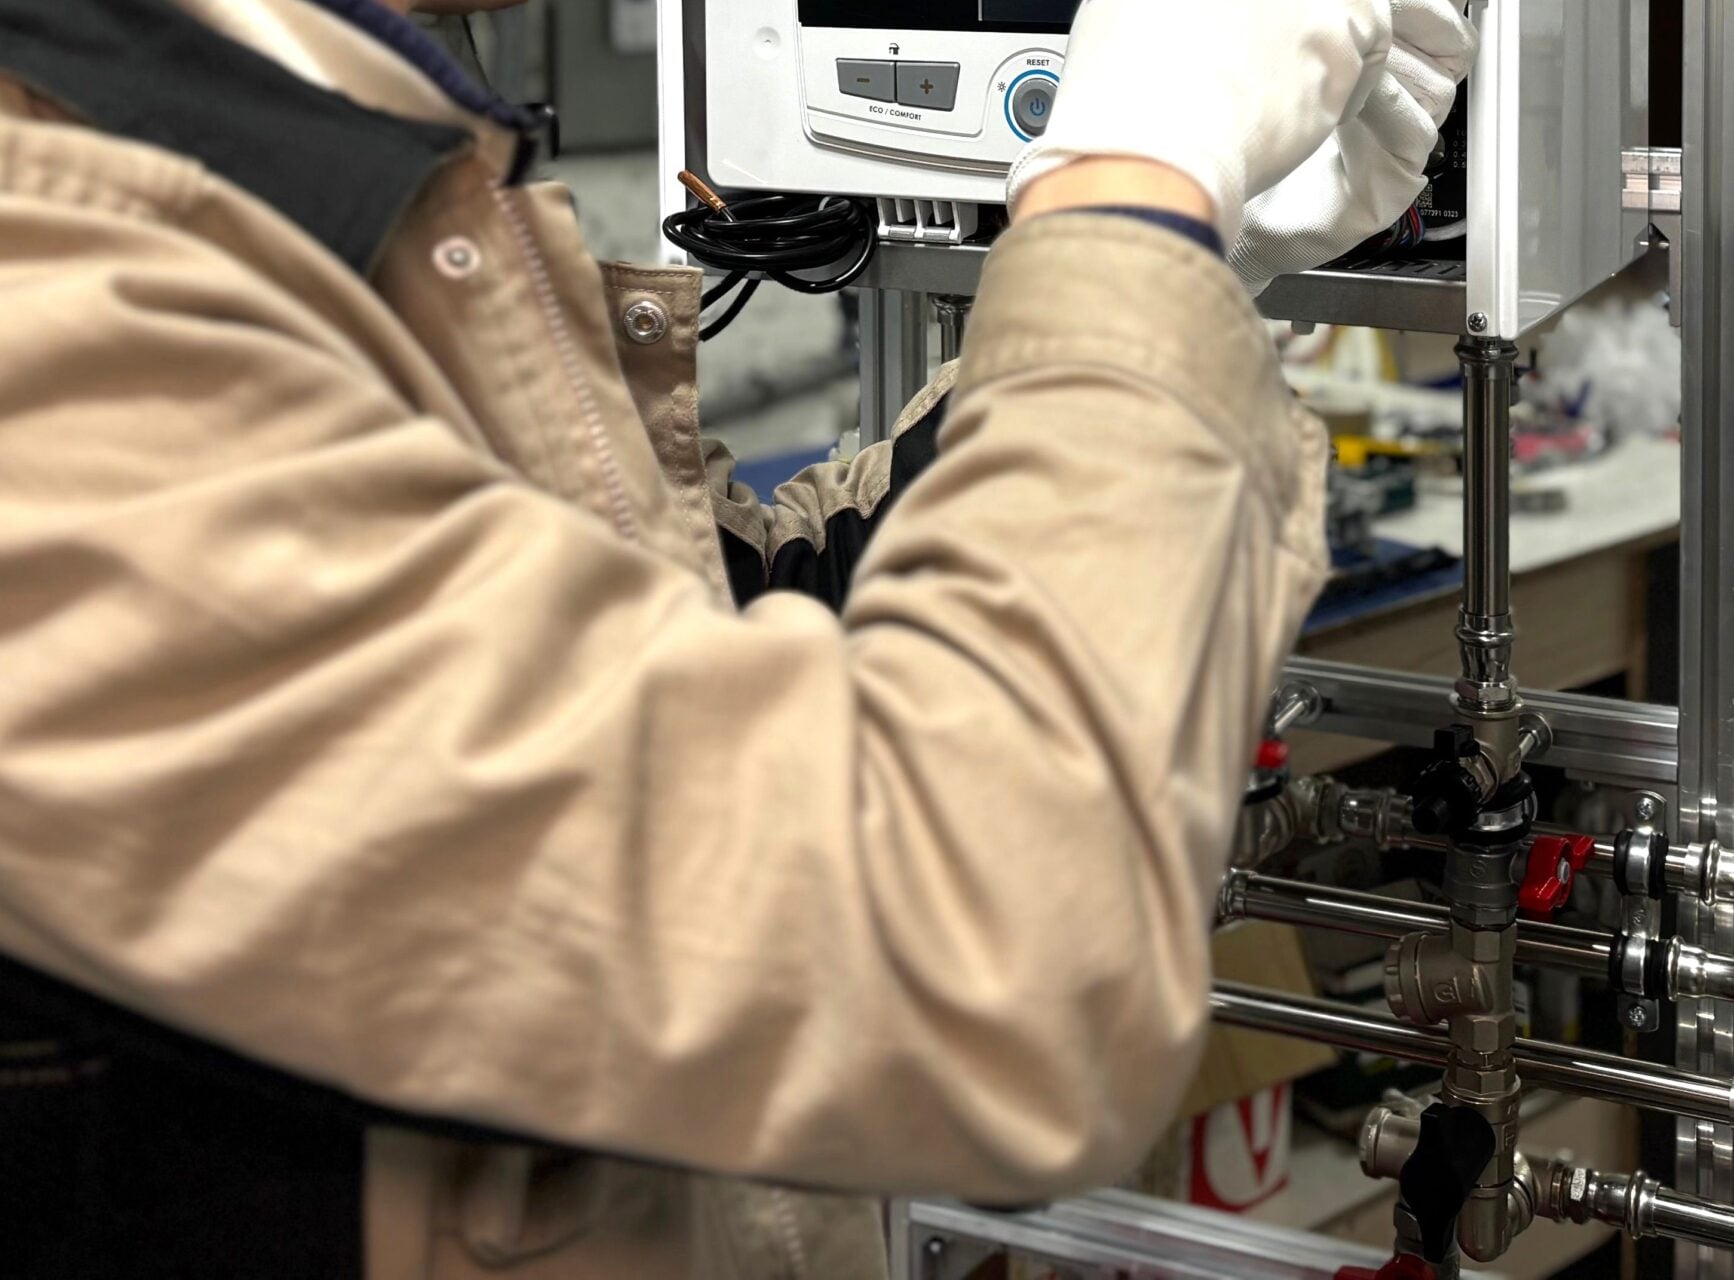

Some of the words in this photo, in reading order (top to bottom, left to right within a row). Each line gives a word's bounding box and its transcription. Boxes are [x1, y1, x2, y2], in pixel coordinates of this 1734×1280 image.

[1026, 58, 1050, 67] RESET
[869, 105, 884, 114] ECO
[889, 110, 922, 121] COMFORT
